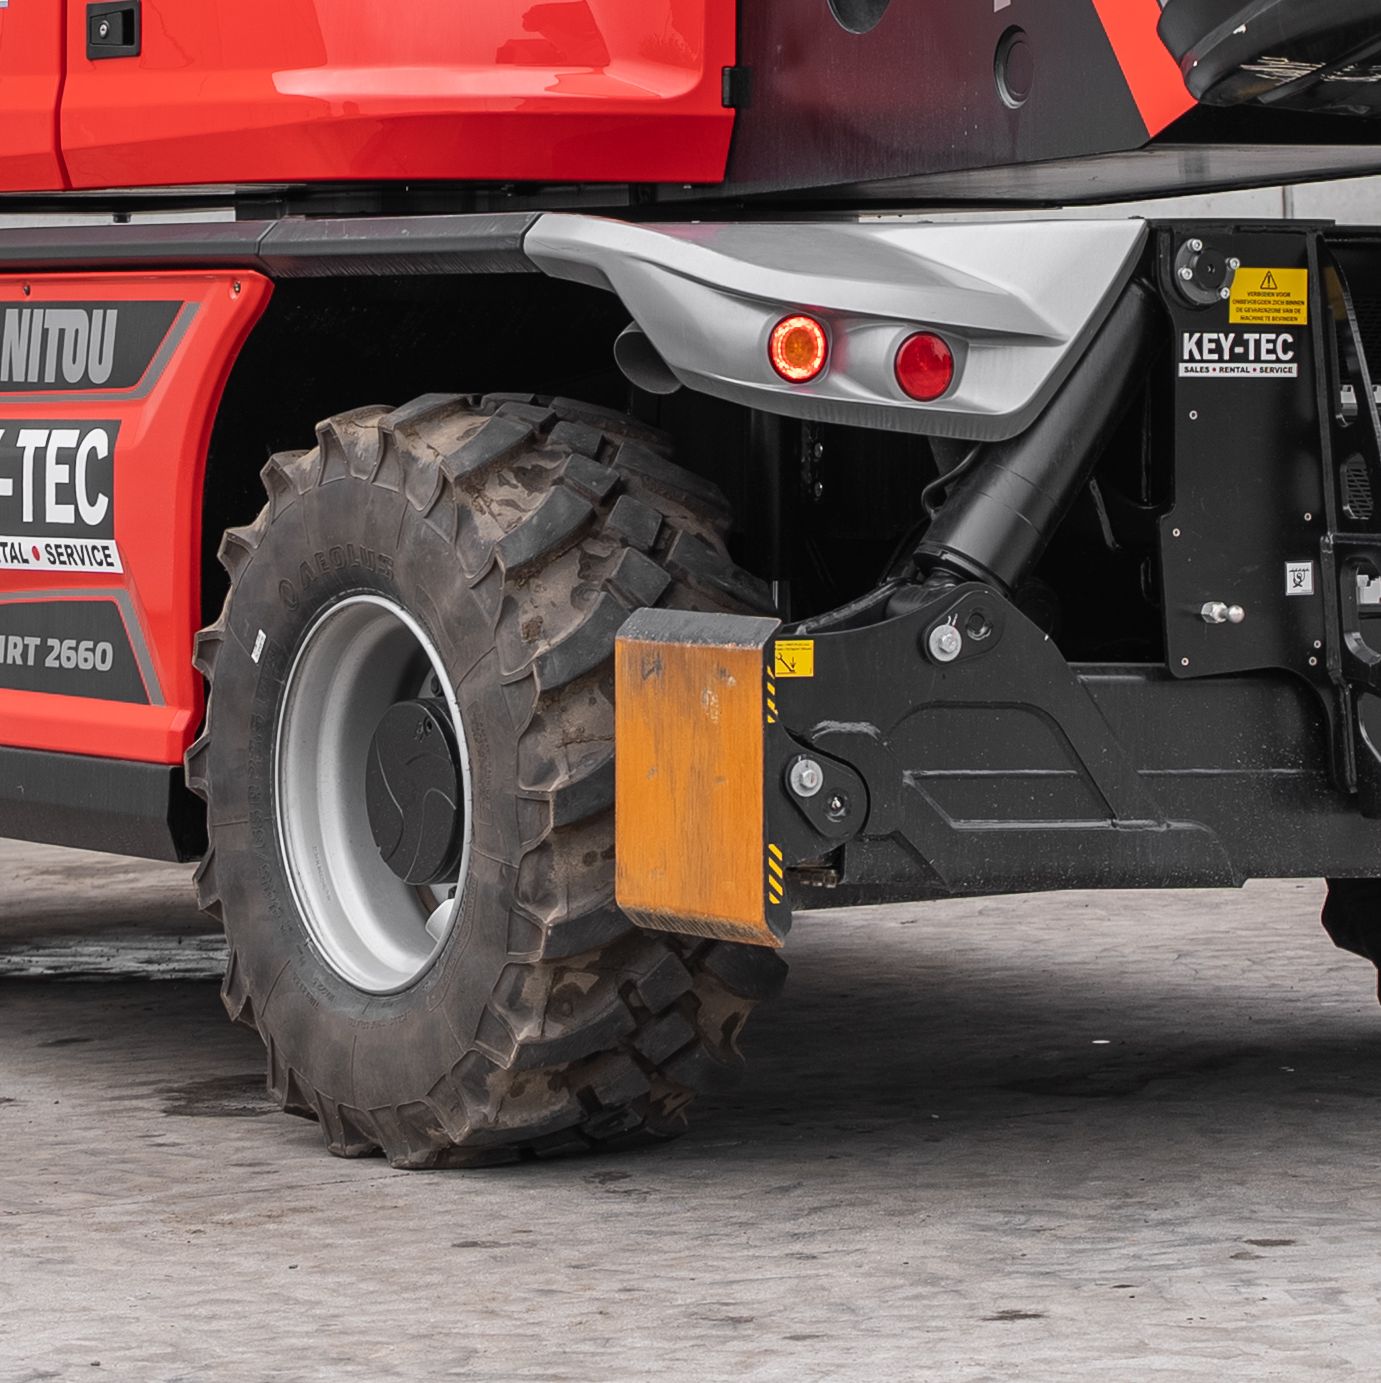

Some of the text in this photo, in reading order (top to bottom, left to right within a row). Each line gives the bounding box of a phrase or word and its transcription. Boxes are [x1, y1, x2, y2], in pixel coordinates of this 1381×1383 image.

[1183, 332, 1294, 361] KEY-TEC
[1184, 366, 1293, 374] SALES RENTAL SERVICE
[44, 542, 116, 568] SERVICE
[44, 638, 114, 672] 2660
